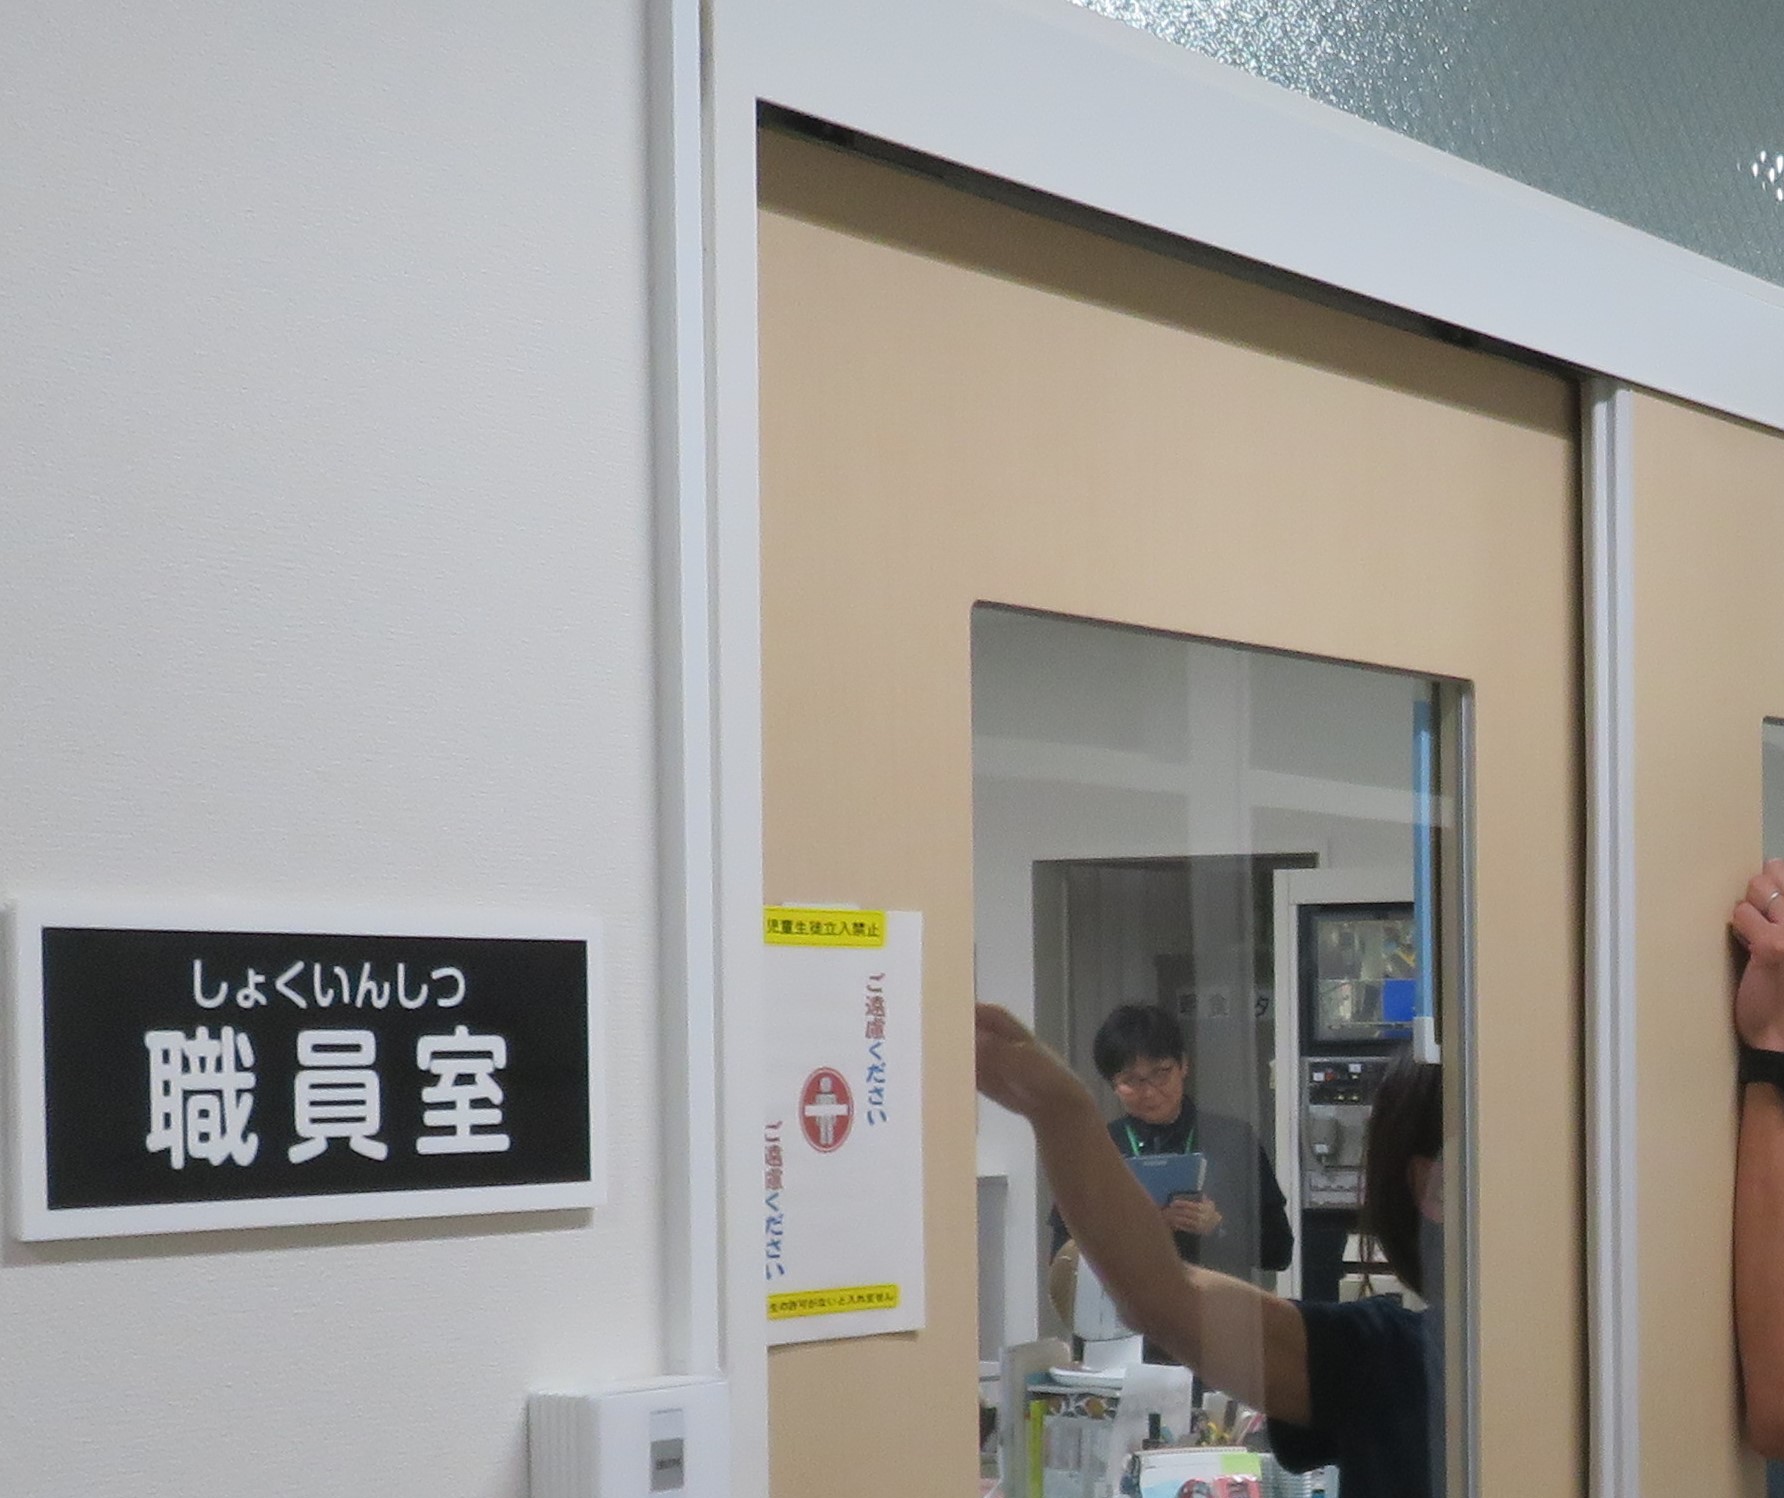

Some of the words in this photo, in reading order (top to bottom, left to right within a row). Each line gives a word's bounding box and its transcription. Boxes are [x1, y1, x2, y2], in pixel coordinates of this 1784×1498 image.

[191, 958, 467, 1011] しょくいんしつ
[144, 1025, 512, 1171] 職員室
